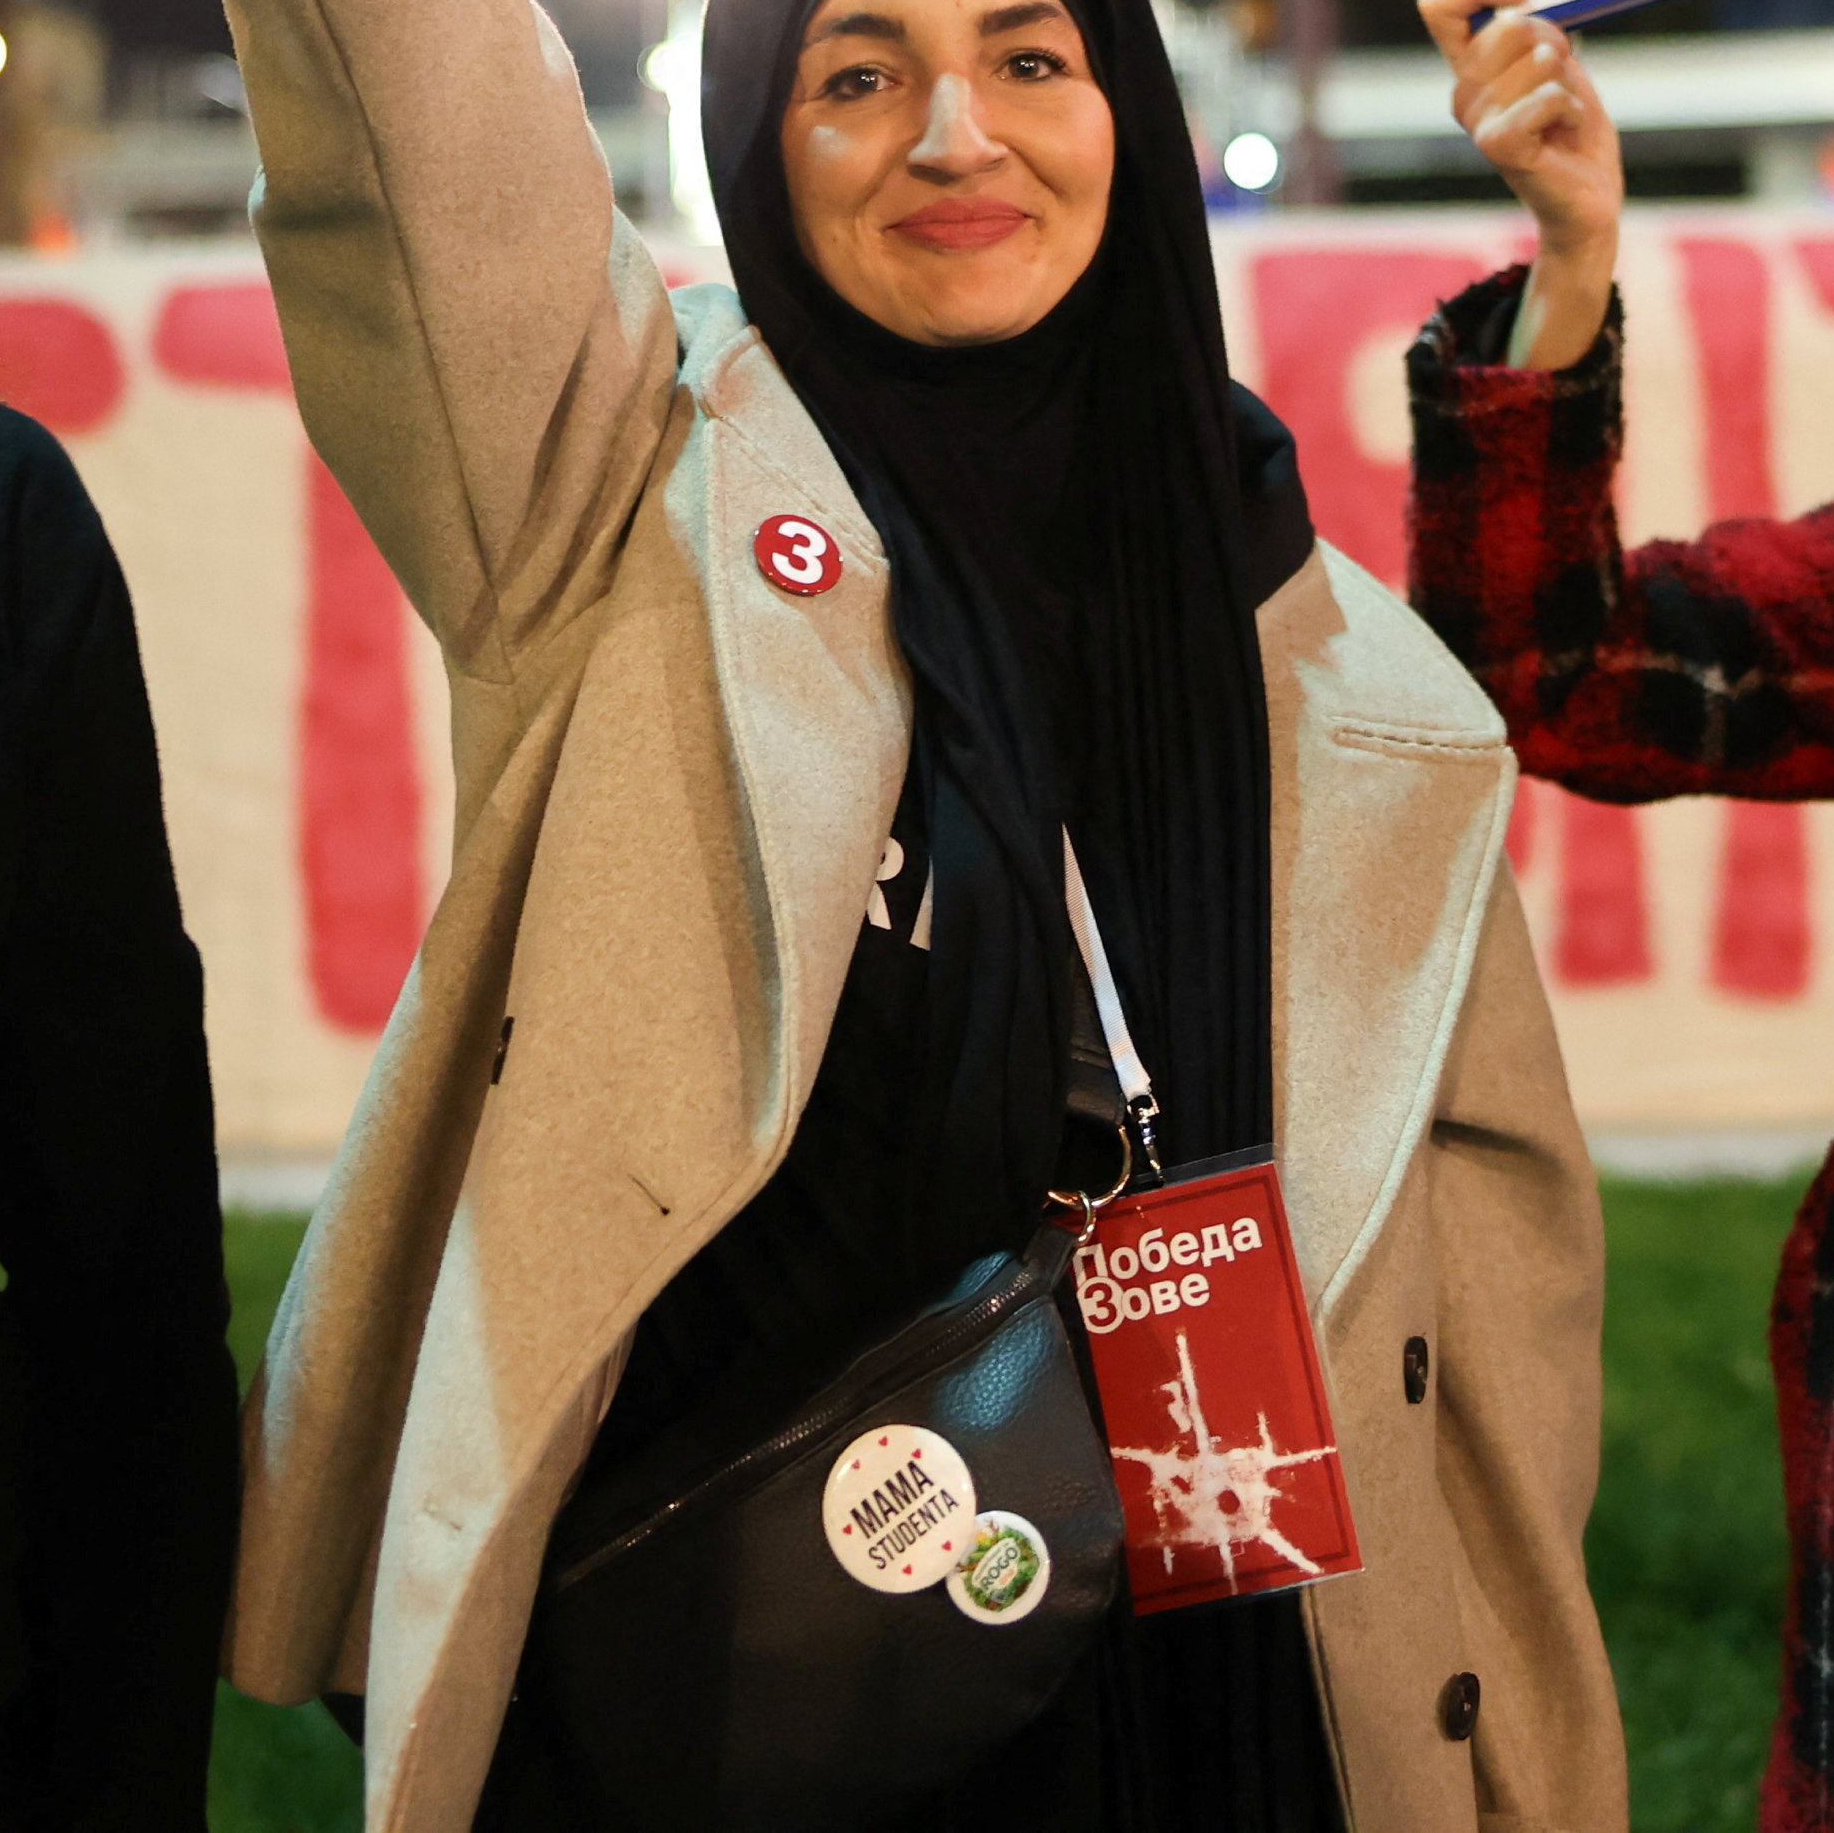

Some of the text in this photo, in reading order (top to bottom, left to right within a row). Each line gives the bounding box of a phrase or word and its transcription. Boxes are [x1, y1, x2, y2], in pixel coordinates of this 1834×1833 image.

[771, 521, 828, 585] 3
[1073, 1217, 1263, 1287] Победа
[849, 1460, 935, 1539] MAMA
[868, 1488, 960, 1570] STUDENTA
